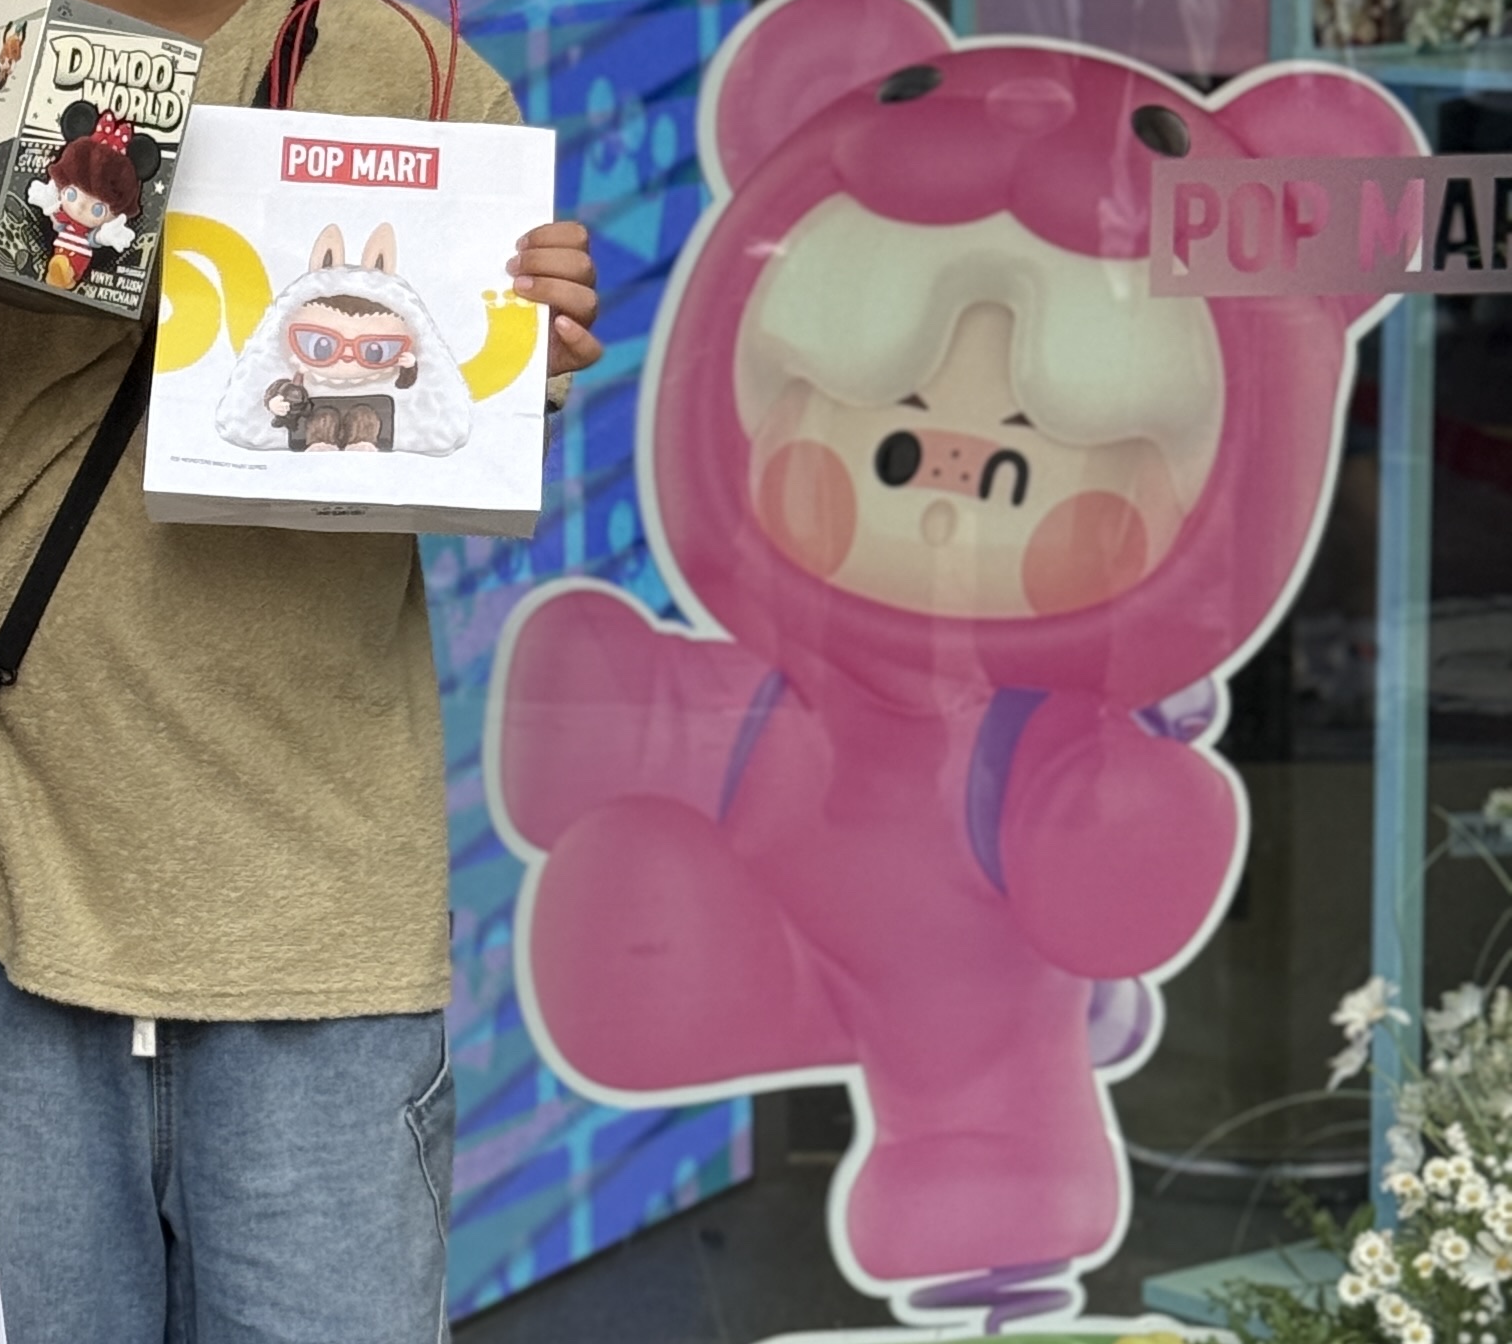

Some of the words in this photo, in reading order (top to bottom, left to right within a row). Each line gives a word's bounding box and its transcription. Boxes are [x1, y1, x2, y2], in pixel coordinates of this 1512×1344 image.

[50, 35, 175, 92] DIMOO
[82, 78, 184, 133] WORLD
[288, 143, 344, 177] POP
[352, 148, 433, 184] MART
[1173, 181, 1330, 276] POP
[91, 269, 114, 287] VINYL
